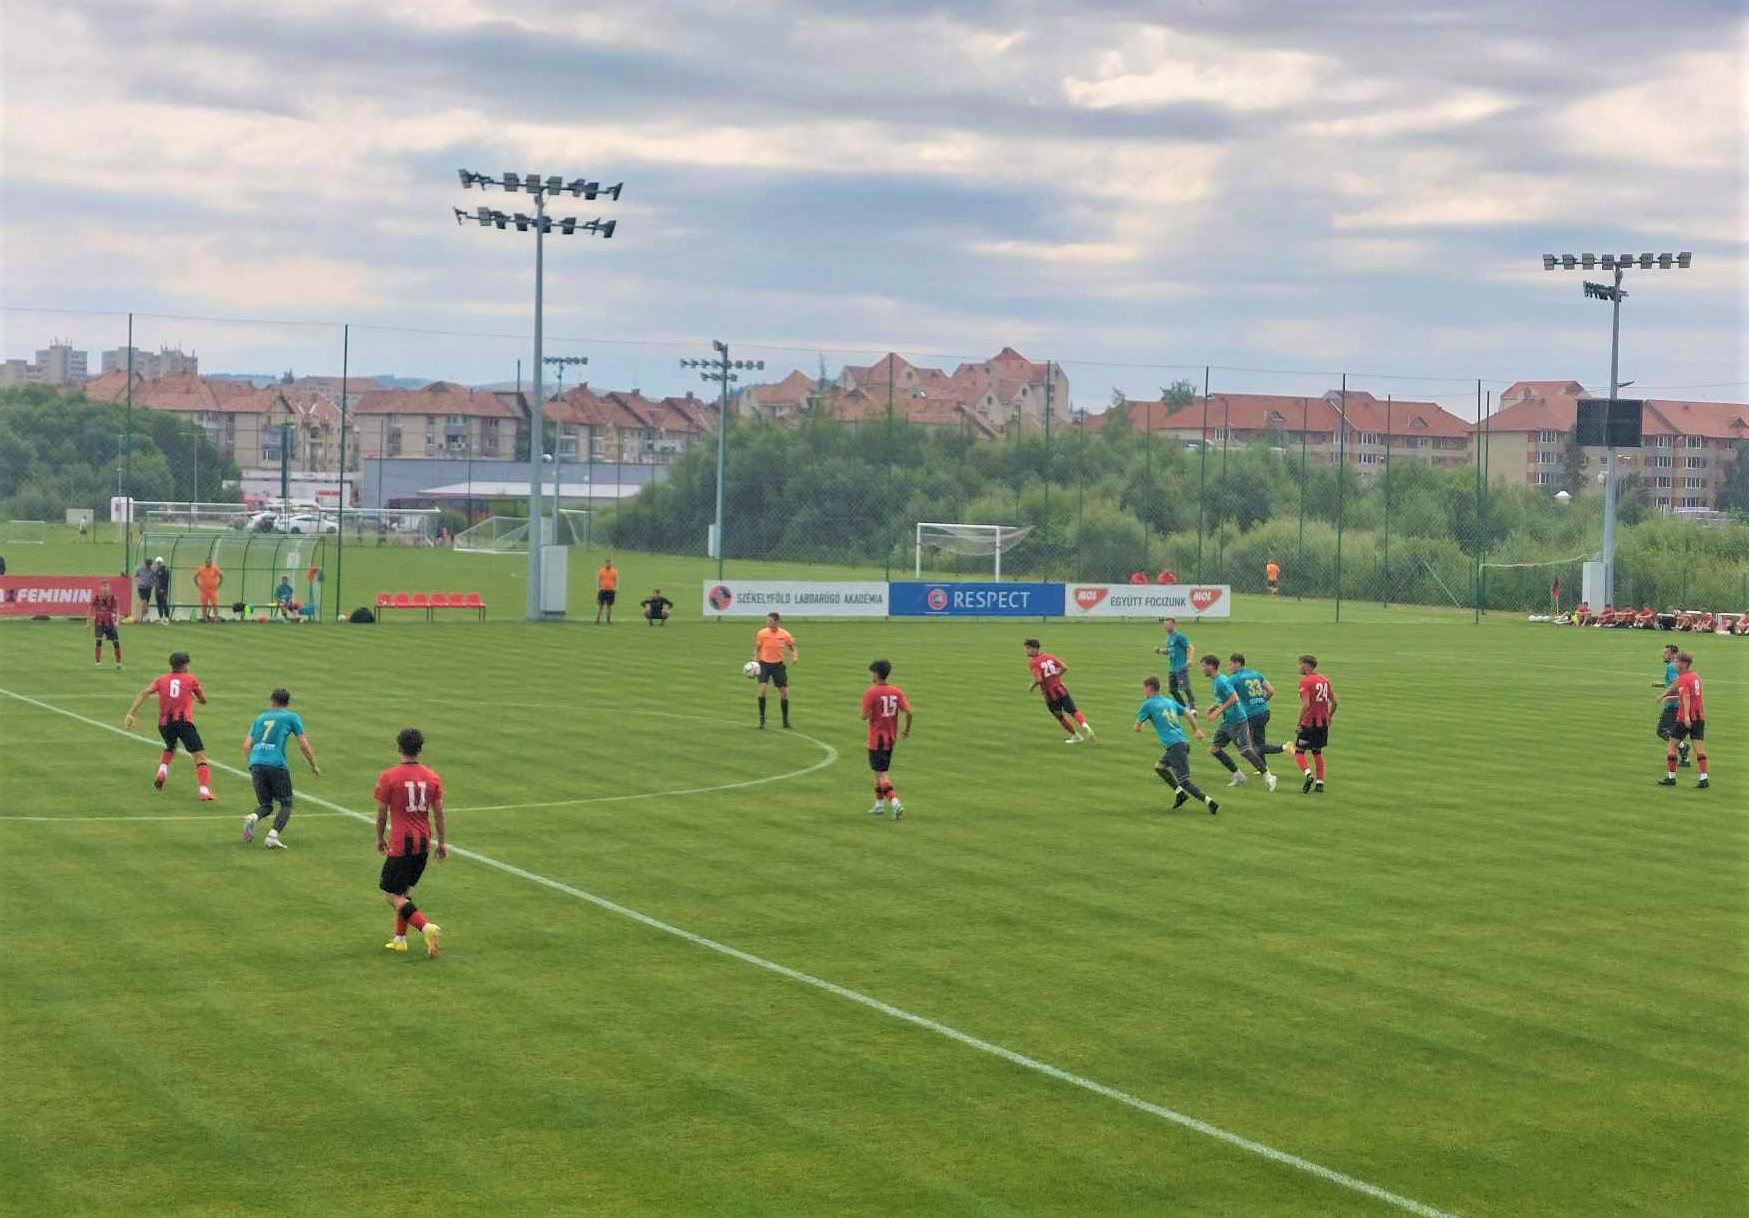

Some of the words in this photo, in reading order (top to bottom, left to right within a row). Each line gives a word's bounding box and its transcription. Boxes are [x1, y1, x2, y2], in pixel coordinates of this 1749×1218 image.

[16, 588, 92, 603] FEMININ
[953, 591, 1031, 608] RESPECT
[1110, 595, 1143, 607] EGYÜTT
[1145, 596, 1186, 607] FOCIZUNK
[170, 679, 180, 698] 6
[1245, 679, 1263, 697] 33
[1315, 682, 1328, 702] 24
[881, 695, 897, 717] 15
[261, 720, 276, 743] 7
[404, 780, 427, 812] 11
